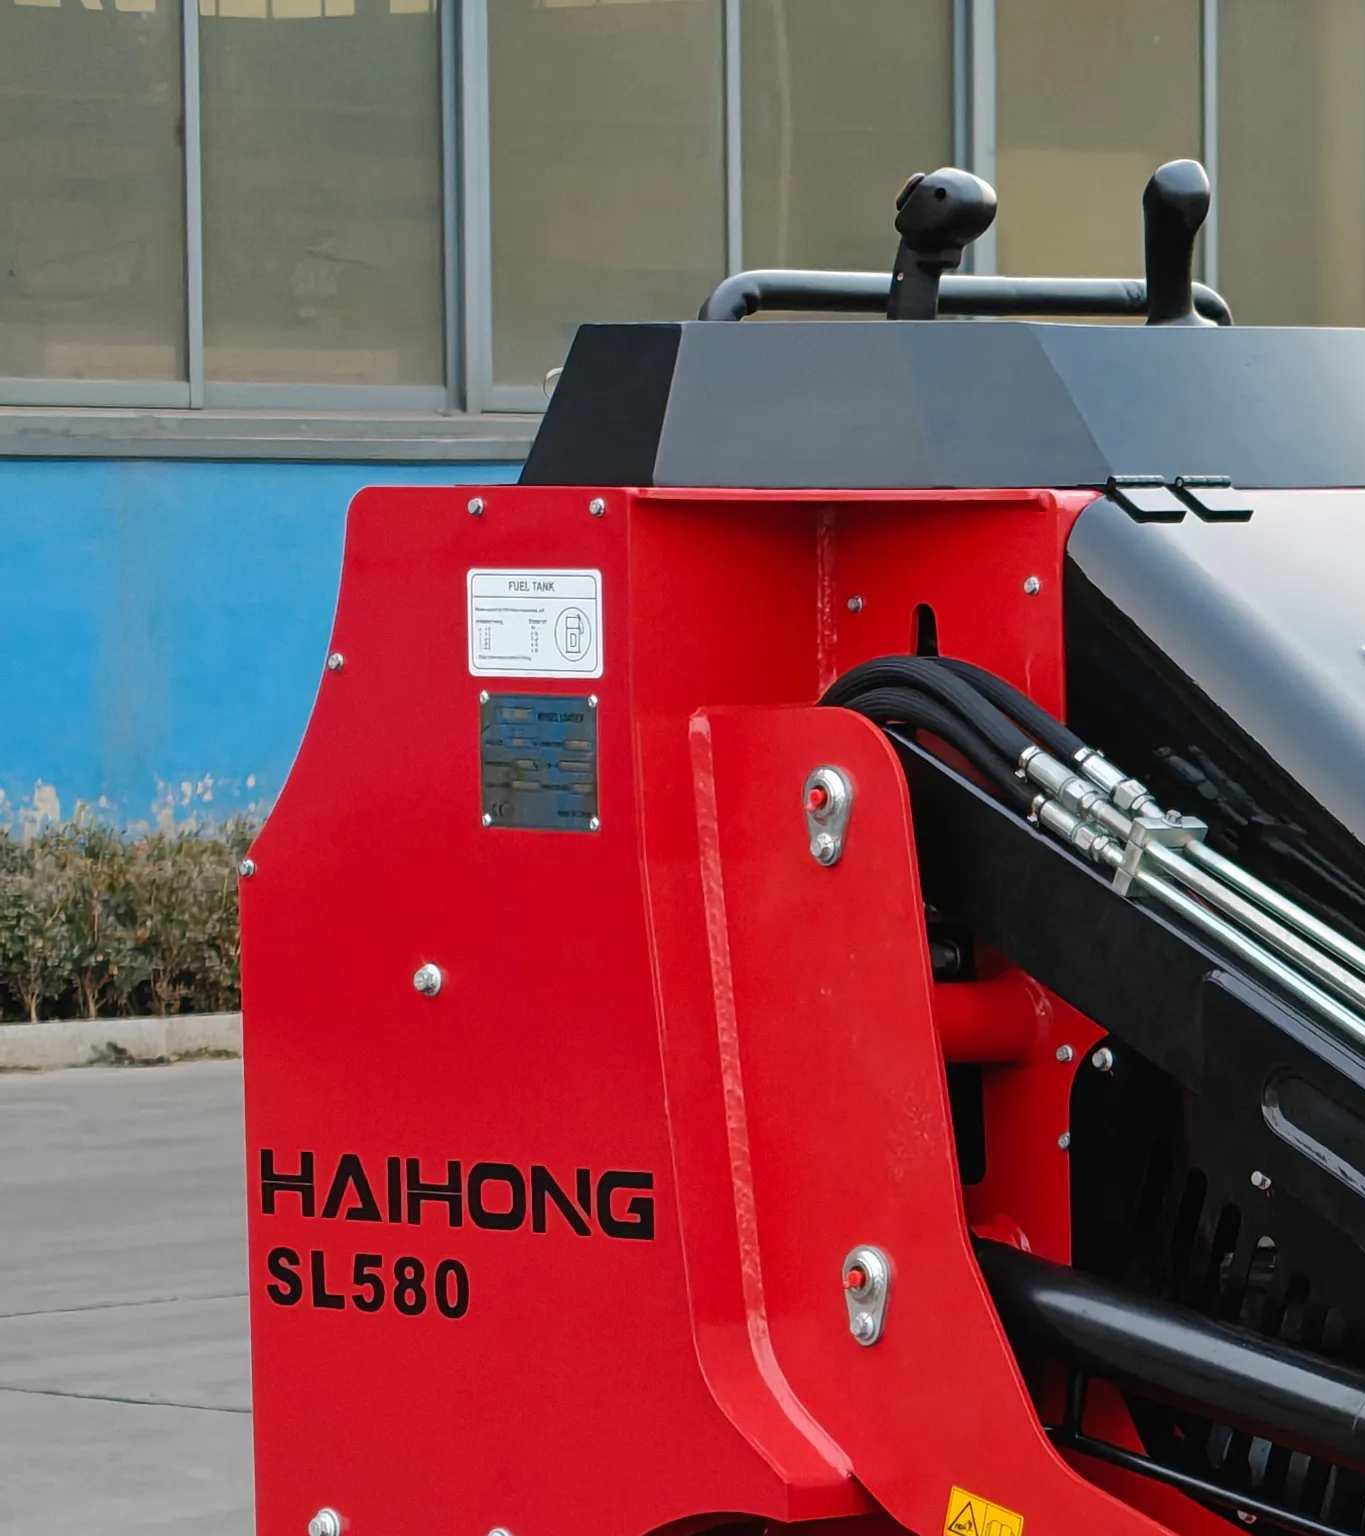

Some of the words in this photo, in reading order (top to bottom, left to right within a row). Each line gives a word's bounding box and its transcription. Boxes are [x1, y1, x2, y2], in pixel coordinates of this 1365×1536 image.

[508, 581, 530, 592] FUEL
[532, 581, 555, 593] TANK
[260, 1149, 654, 1241] HAIHONG
[266, 1247, 469, 1319] SL580
